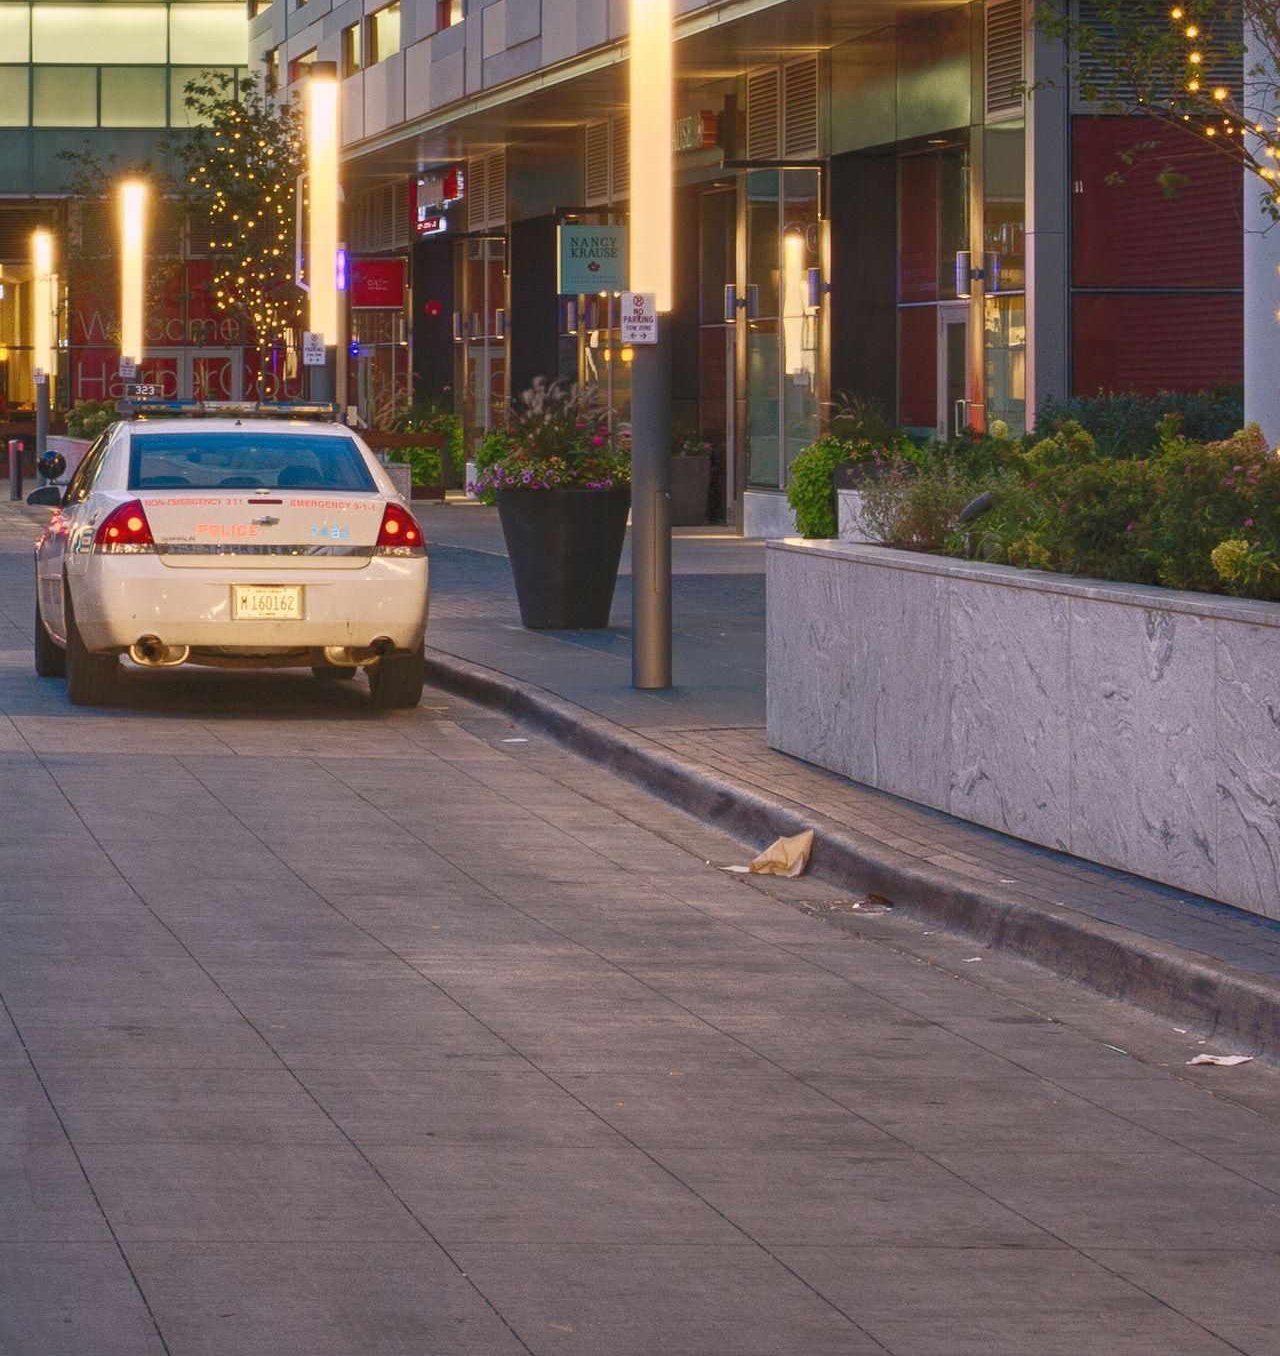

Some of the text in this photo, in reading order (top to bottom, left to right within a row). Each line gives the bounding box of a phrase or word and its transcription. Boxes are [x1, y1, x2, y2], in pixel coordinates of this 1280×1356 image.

[571, 237, 617, 247] NANCY
[571, 248, 618, 258] KRAUSE
[623, 315, 654, 323] PARKING
[78, 310, 240, 341] Wcome
[78, 361, 304, 399] HarperCou
[135, 386, 155, 395] 323
[145, 499, 222, 507] NON-EMERGENCY
[290, 500, 351, 508] EMERGENCY
[196, 524, 257, 538] POLICE
[252, 595, 295, 611] 160162
